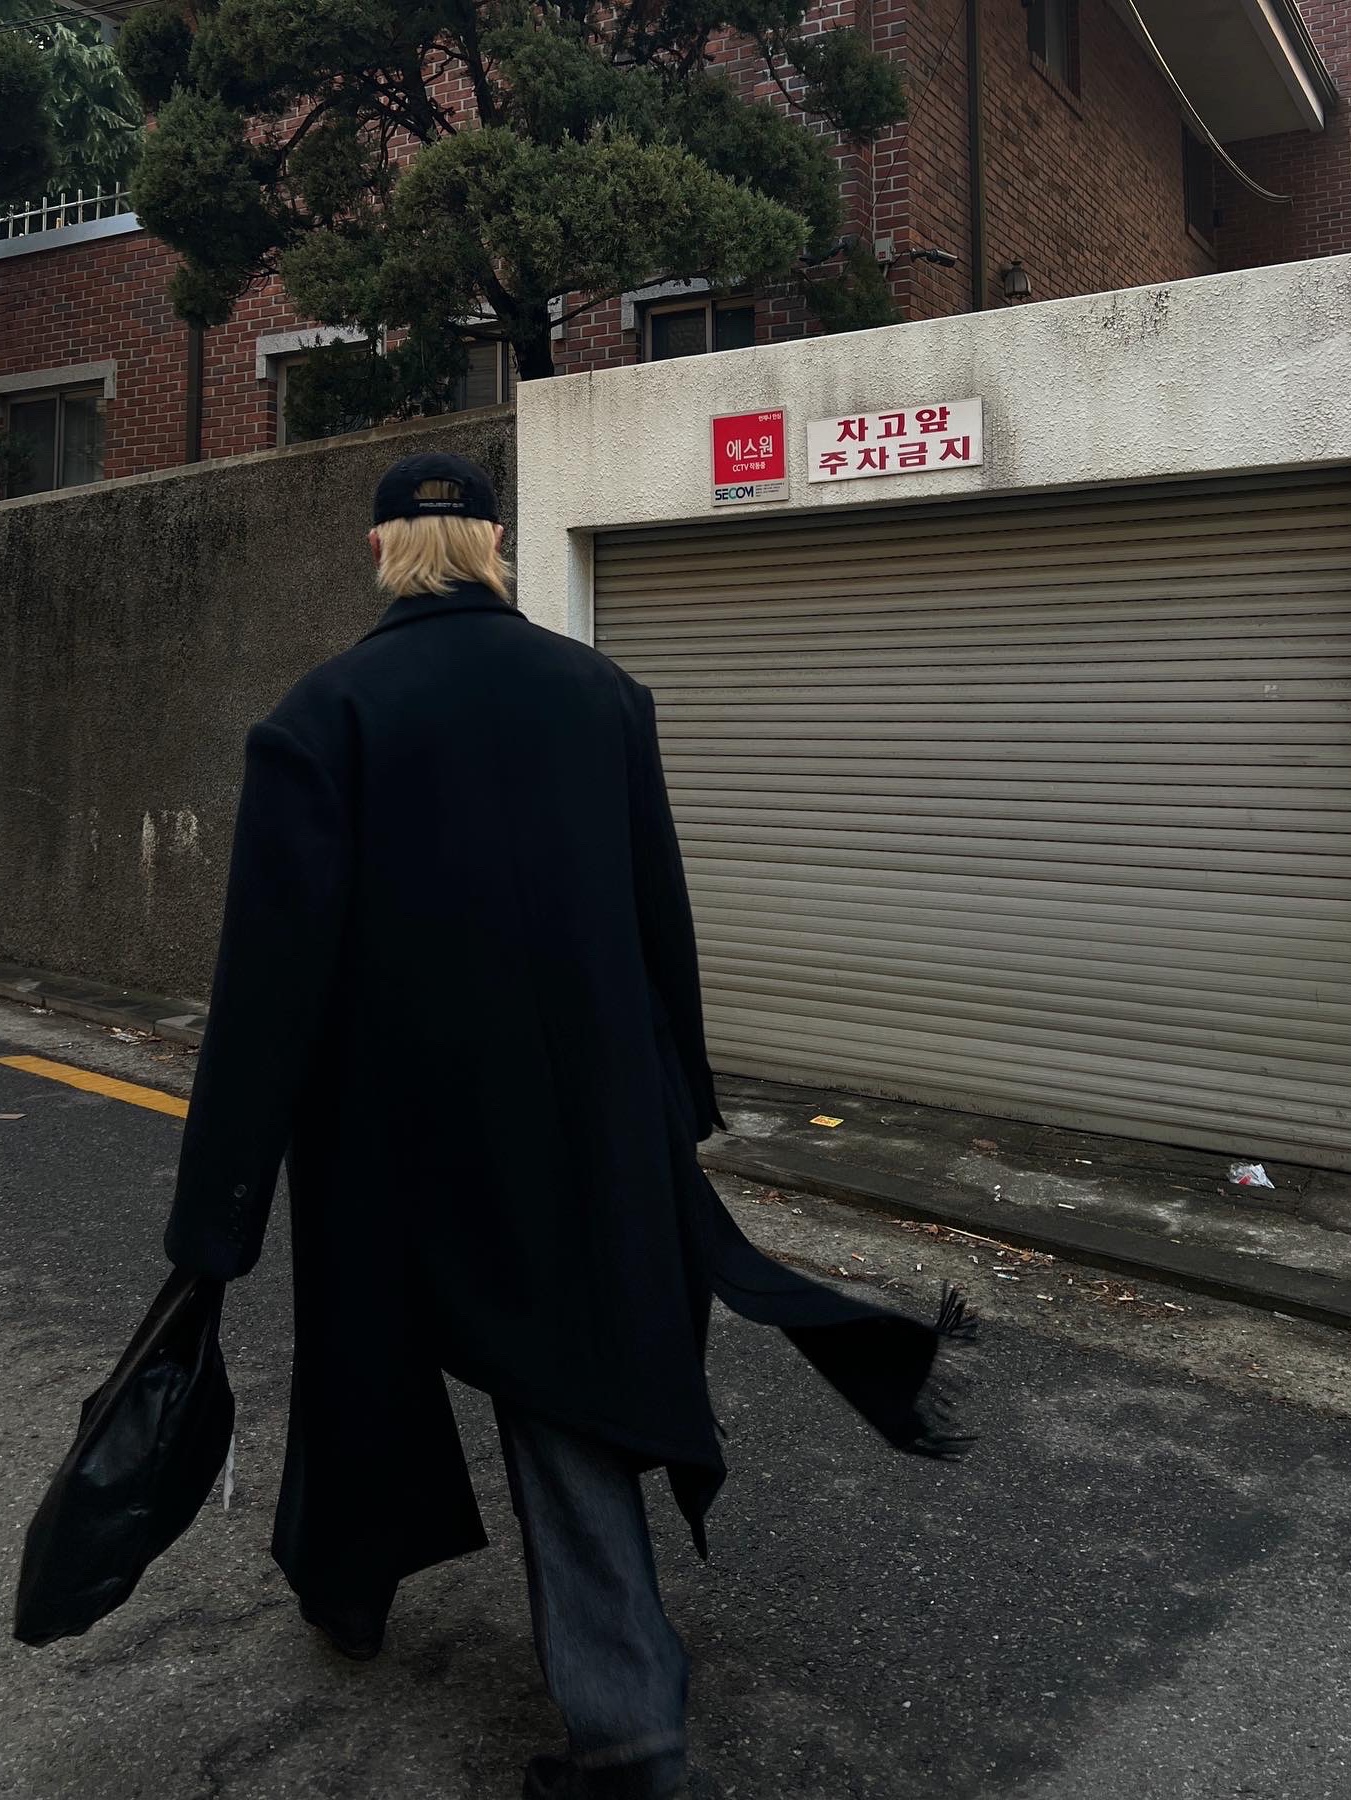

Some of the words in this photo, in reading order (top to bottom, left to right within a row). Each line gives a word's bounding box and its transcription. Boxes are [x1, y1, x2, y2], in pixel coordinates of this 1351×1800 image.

[836, 405, 951, 443] 차고앞
[726, 435, 773, 461] 에스원
[818, 435, 971, 476] 주차금지
[732, 463, 749, 473] CCTV
[715, 486, 754, 501] SECOM
